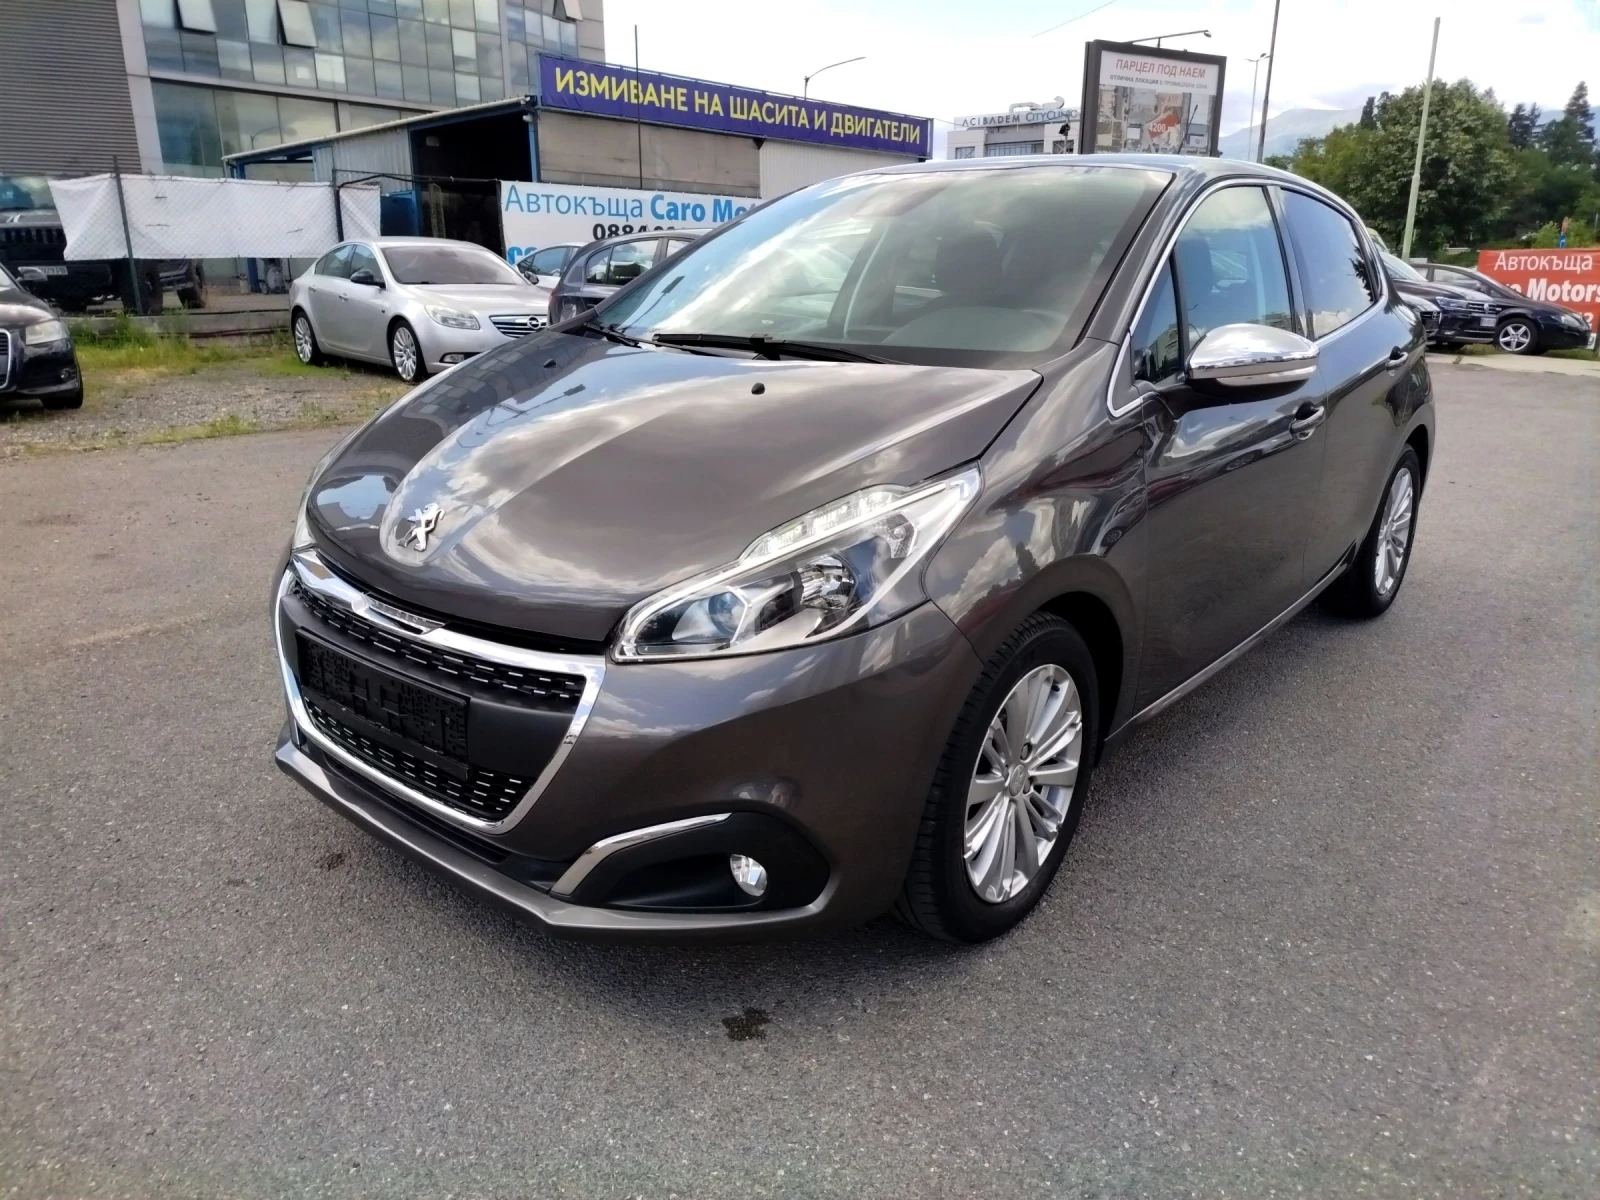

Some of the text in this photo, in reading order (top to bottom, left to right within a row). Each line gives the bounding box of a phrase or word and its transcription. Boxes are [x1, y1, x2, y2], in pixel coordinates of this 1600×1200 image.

[1116, 59, 1206, 78] ПАРЦЕЛ ПОД НАЕМ
[1109, 74, 1134, 82] ОТЛИЧНА
[1135, 77, 1159, 85] ЛОКАЦИЯ
[555, 67, 920, 144] ИЗМИВАНЕ НА ШАСИТА И ДВИГАТЕЛИ
[962, 114, 1020, 127] ACIBADEM
[504, 184, 756, 222] Автокъща Caro Mo
[1494, 252, 1593, 274] Автокъща
